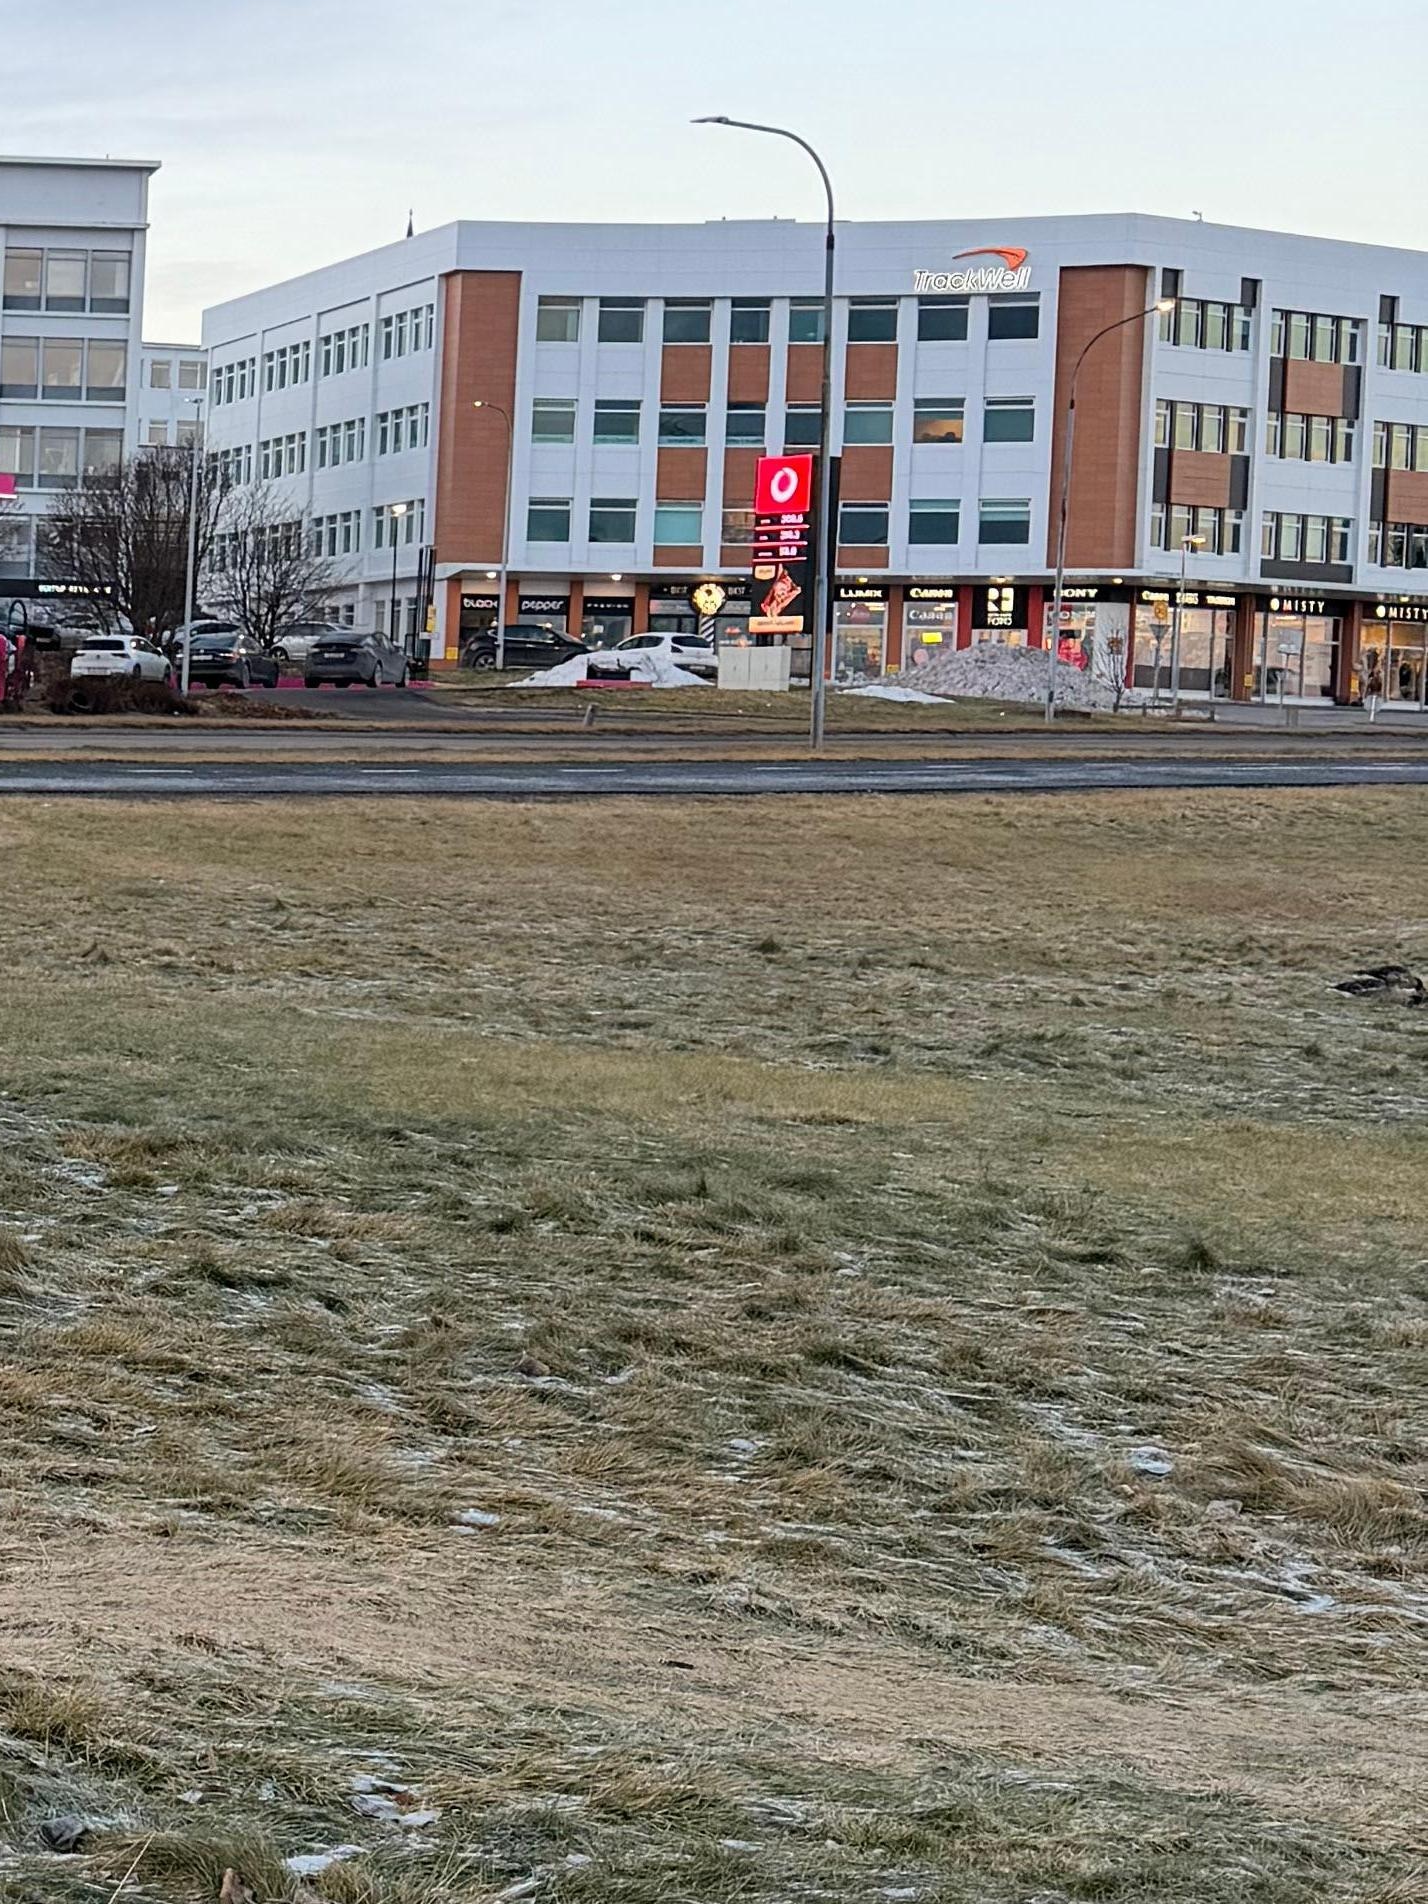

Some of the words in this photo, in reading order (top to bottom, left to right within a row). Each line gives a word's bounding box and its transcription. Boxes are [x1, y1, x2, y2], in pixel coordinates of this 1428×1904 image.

[914, 266, 1032, 292] TrackWell
[521, 599, 565, 611] pepper
[1283, 598, 1325, 614] MISTY
[1388, 606, 1428, 620] MISTY
